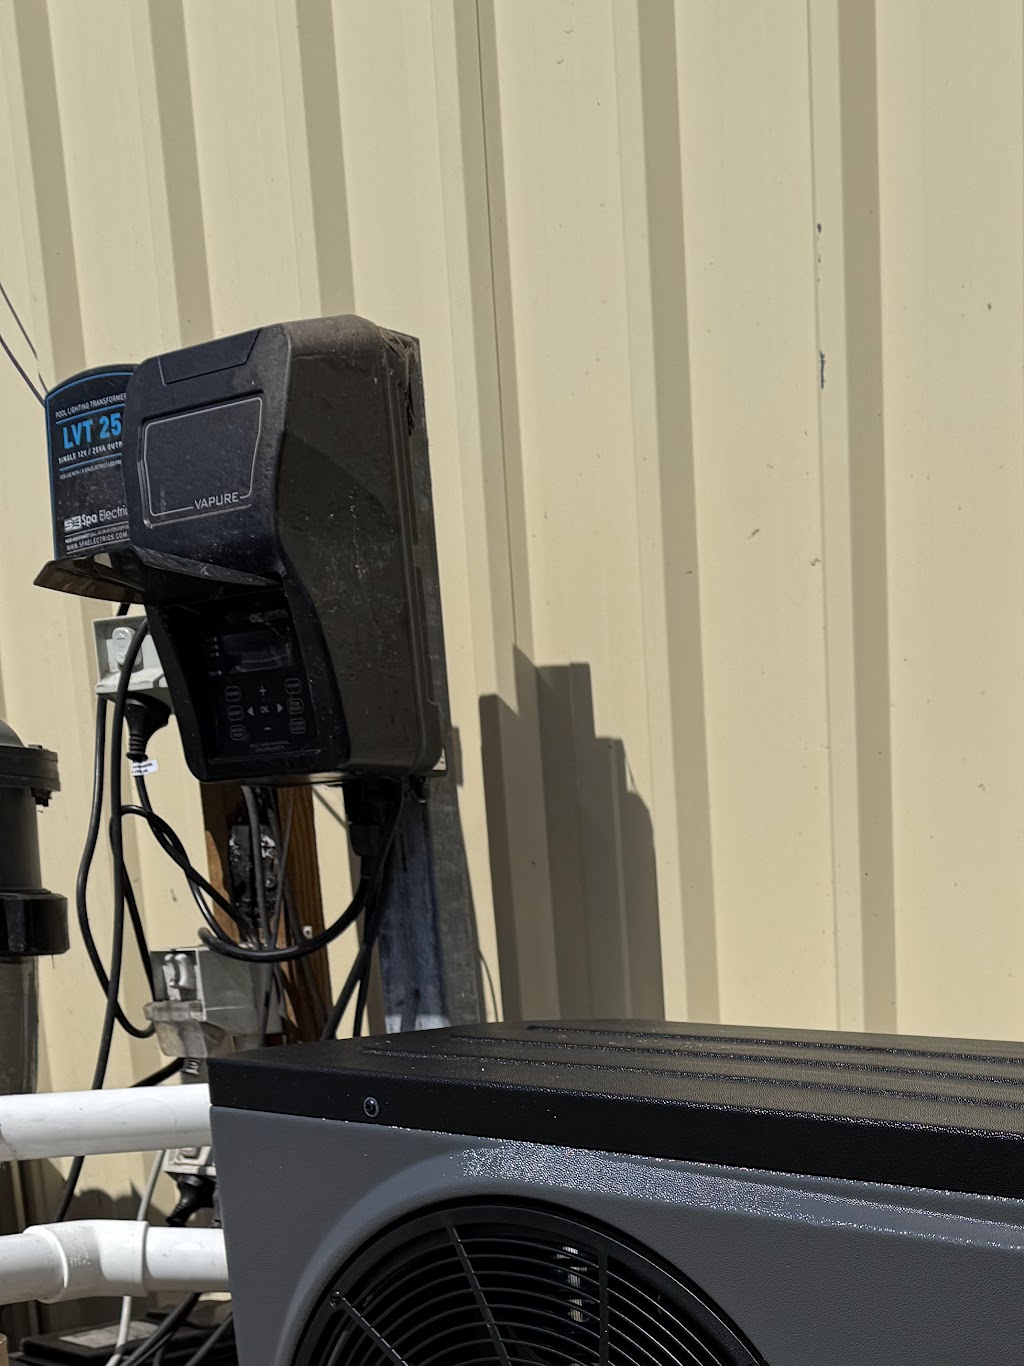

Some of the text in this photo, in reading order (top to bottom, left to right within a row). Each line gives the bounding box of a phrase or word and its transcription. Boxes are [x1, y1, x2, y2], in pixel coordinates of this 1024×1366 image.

[62, 412, 122, 449] LVT 25
[194, 491, 239, 510] VAPURE
[81, 514, 98, 527] Spa
